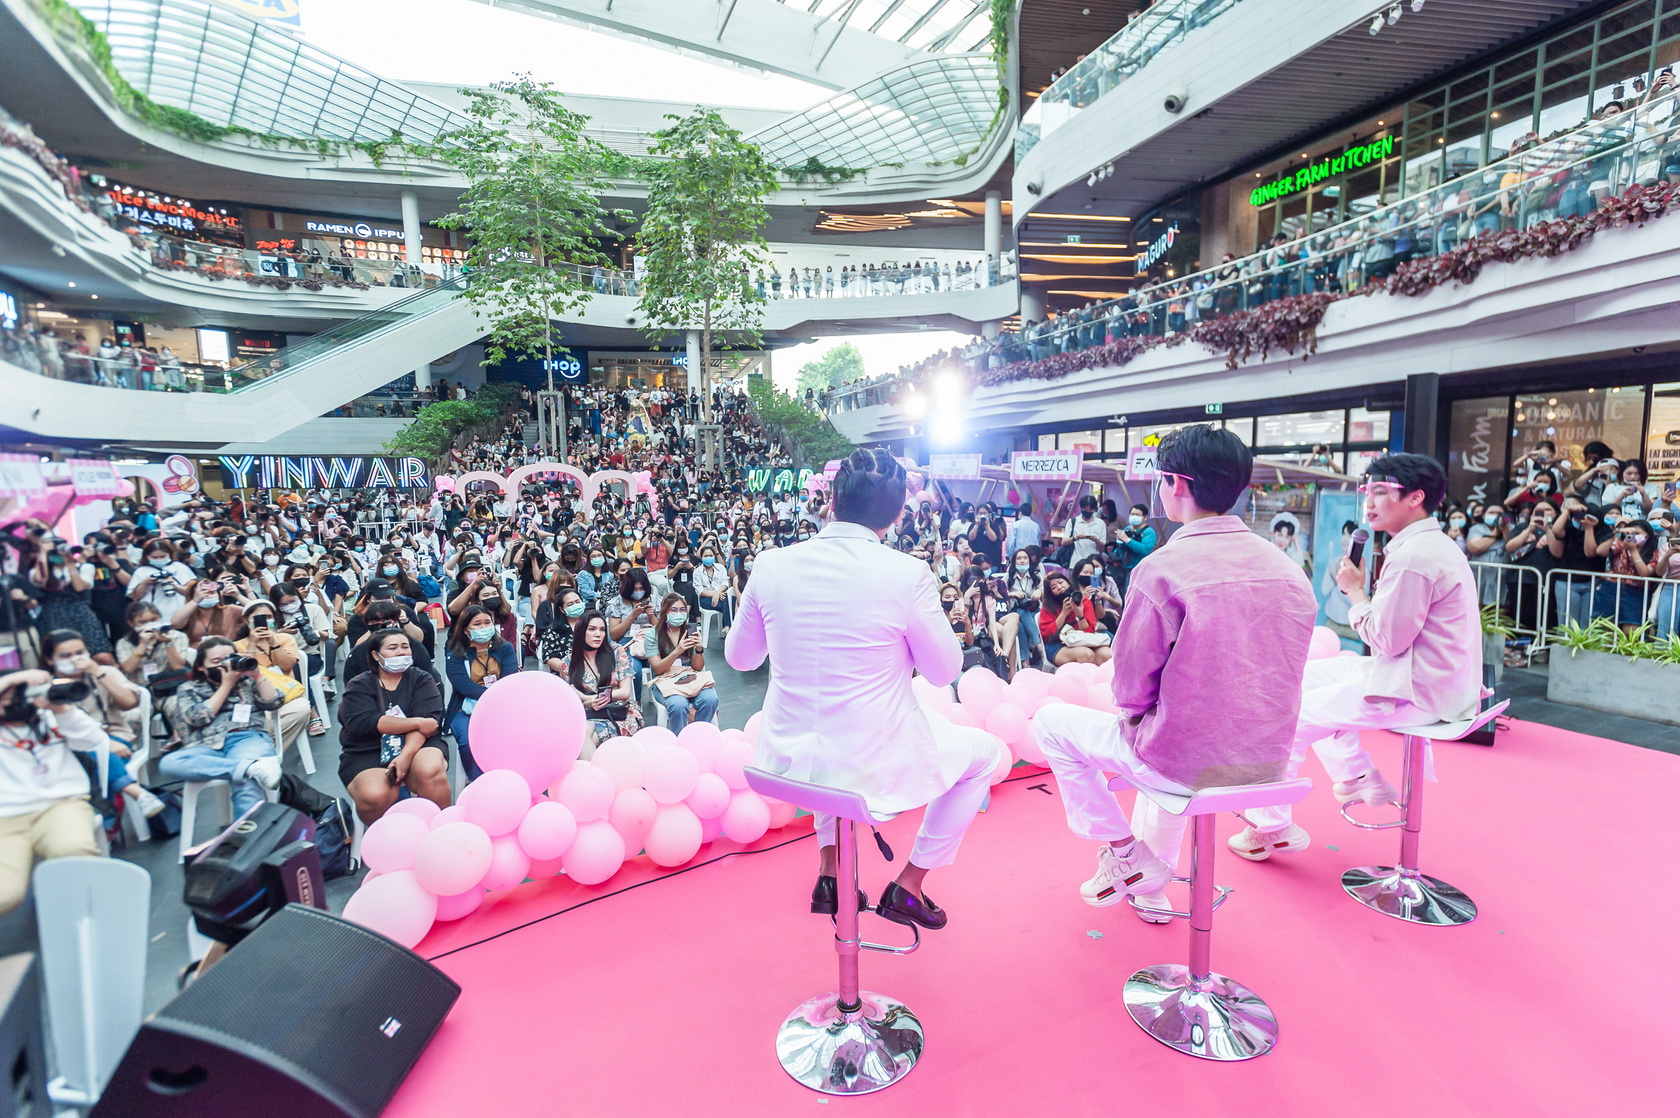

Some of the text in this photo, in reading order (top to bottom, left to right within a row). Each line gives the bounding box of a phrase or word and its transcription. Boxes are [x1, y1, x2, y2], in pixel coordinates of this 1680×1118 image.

[1249, 134, 1393, 206] GINGER FARM KITCHEN
[306, 221, 423, 241] RAMEN IPPU
[1137, 226, 1175, 275] MAGURO
[1525, 400, 1626, 425] ORGANIC
[1461, 416, 1492, 473] Farm
[1524, 425, 1605, 442] & NATURAL
[217, 455, 429, 489] YINWAR
[1250, 832, 1280, 846] GUCCI
[1096, 859, 1133, 886] GUCCI
